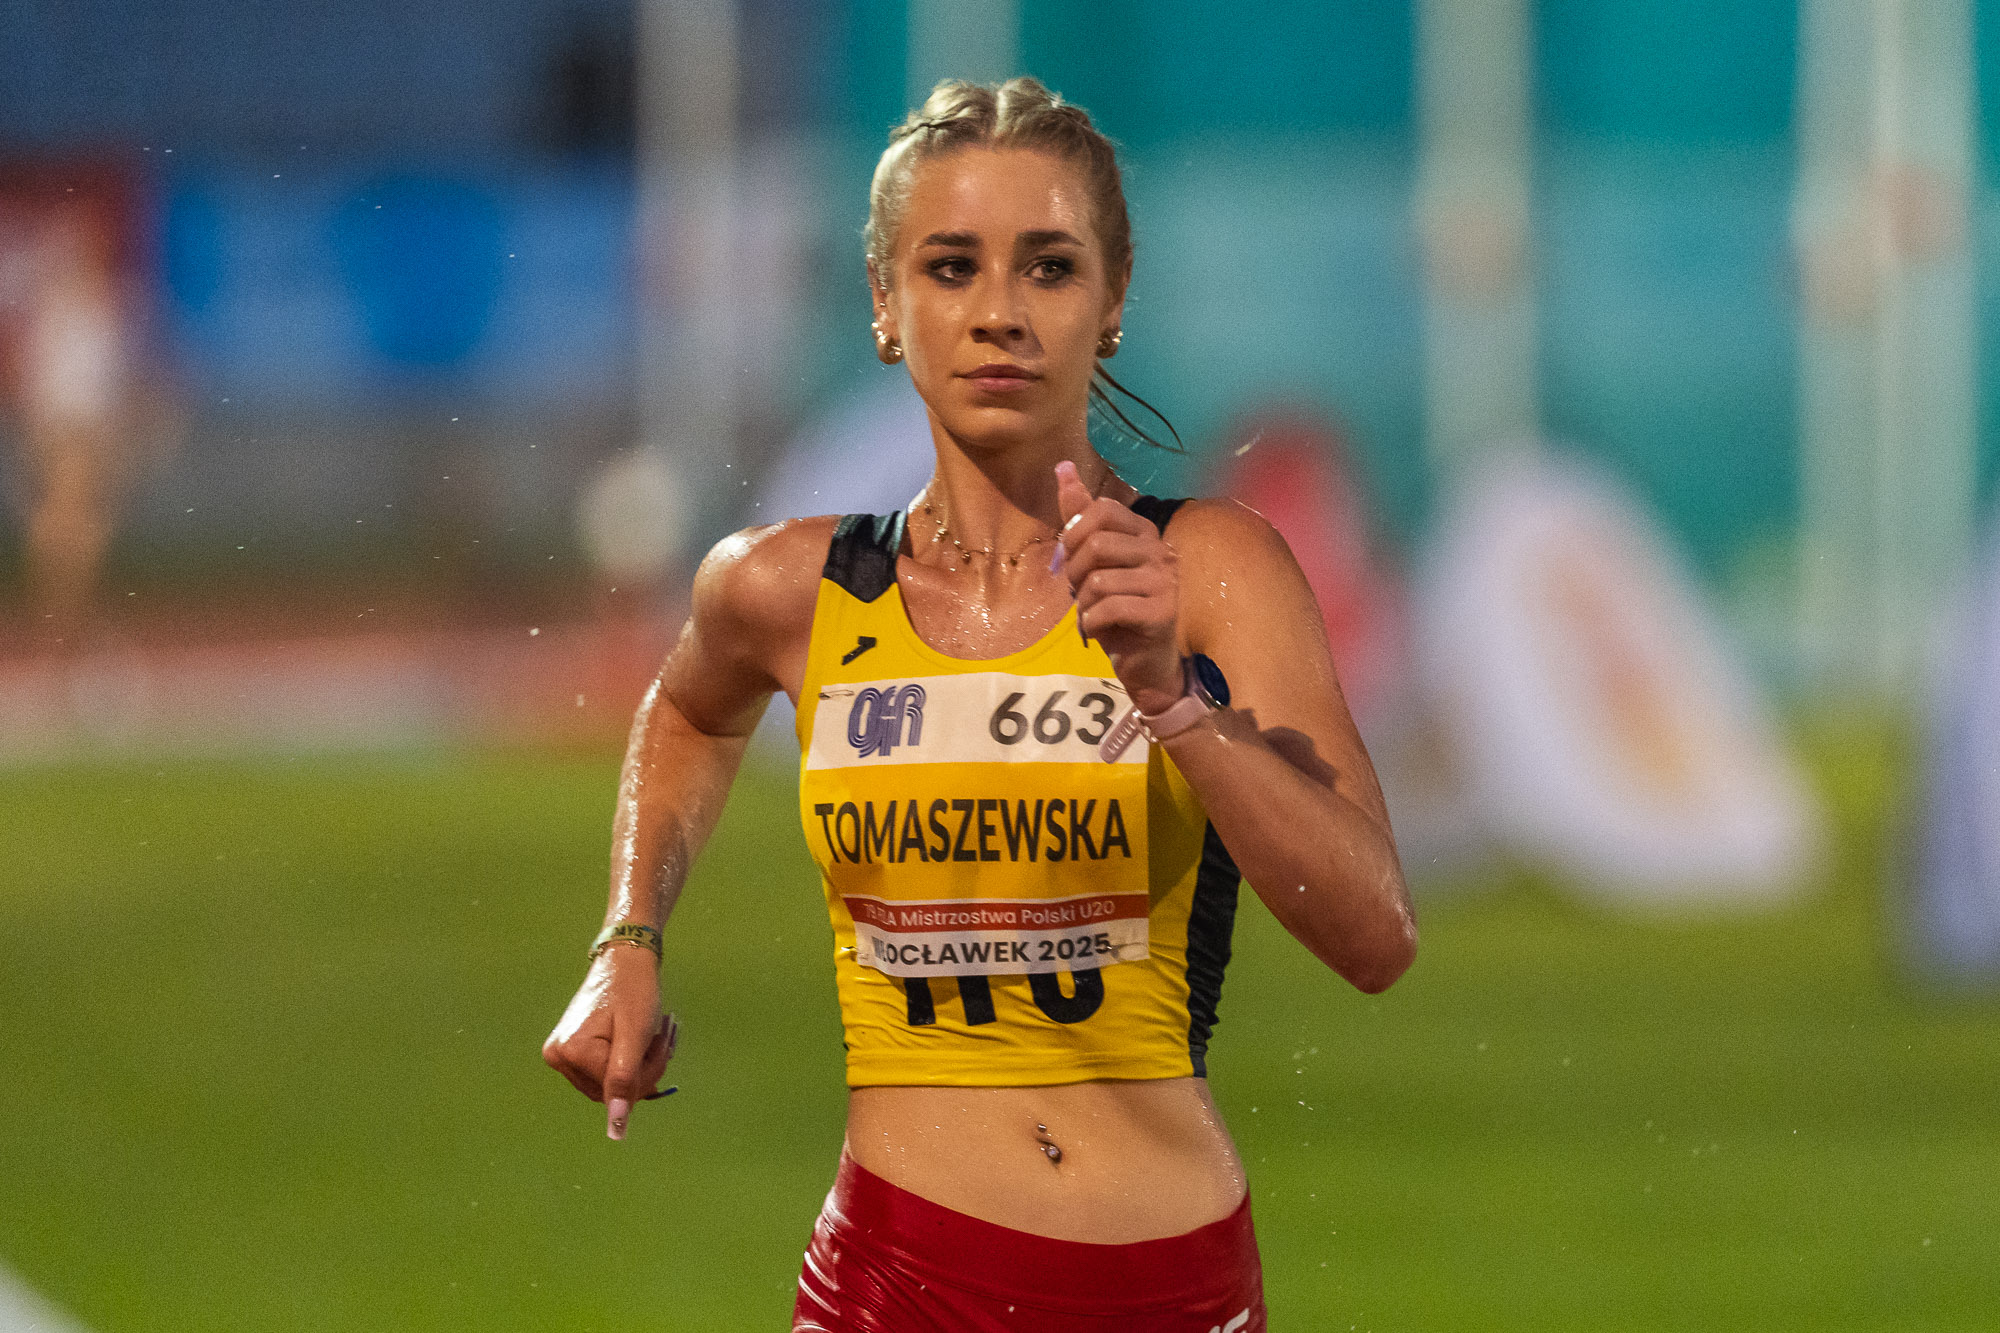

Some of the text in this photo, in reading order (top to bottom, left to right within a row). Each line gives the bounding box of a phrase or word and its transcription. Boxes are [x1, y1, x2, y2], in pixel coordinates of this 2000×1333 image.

[989, 690, 1115, 745] 663
[815, 798, 1132, 864] TOMASZEWSKA
[901, 910, 1016, 926] Mistrzostwa
[1021, 905, 1075, 925] Polski
[1080, 900, 1115, 919] U20
[872, 932, 1112, 966] OCŁAWEK 2025
